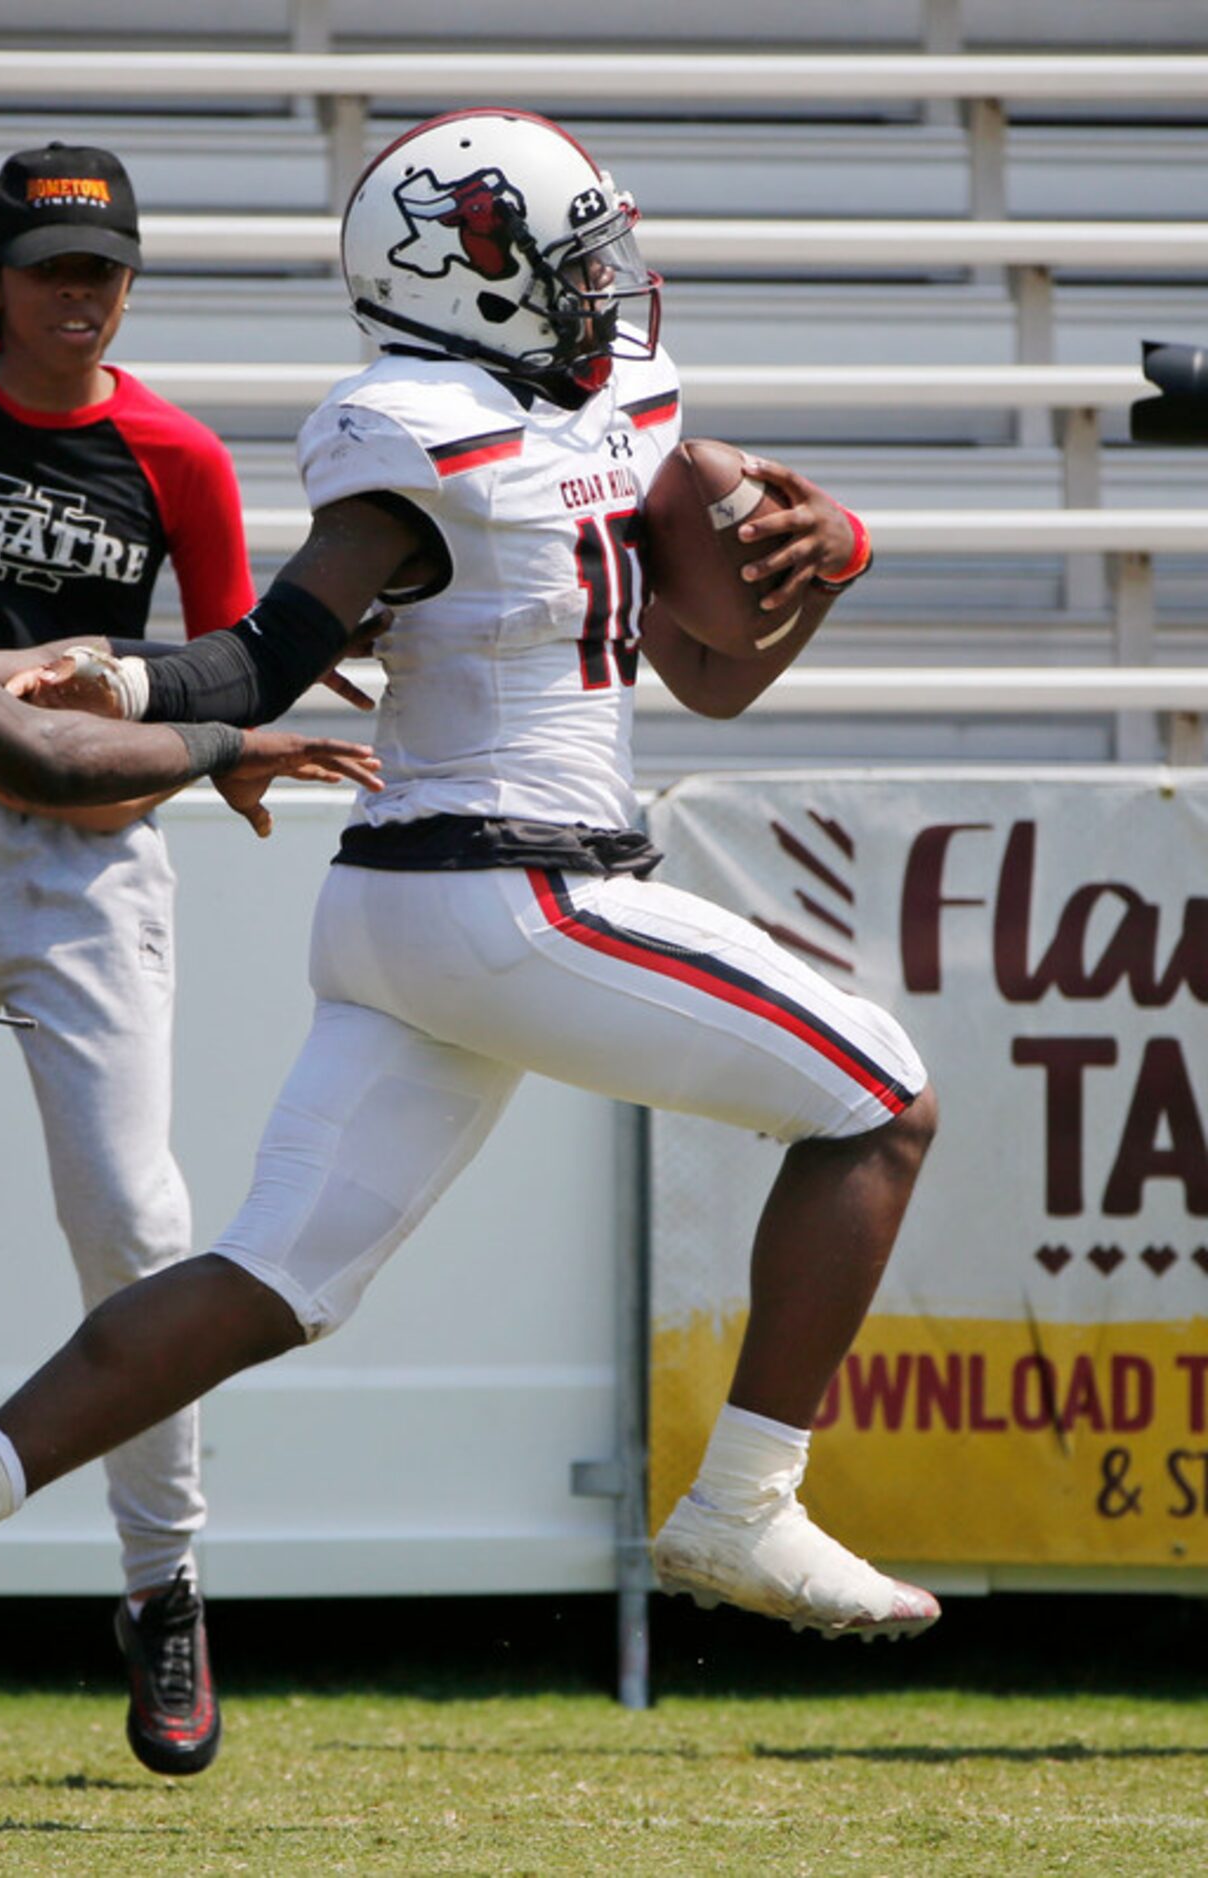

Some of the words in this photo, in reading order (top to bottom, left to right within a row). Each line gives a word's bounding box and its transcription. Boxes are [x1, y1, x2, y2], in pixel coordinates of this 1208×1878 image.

[560, 474, 606, 509] CEDAR
[1012, 1037, 1208, 1217] TA
[1096, 1447, 1142, 1519] &
